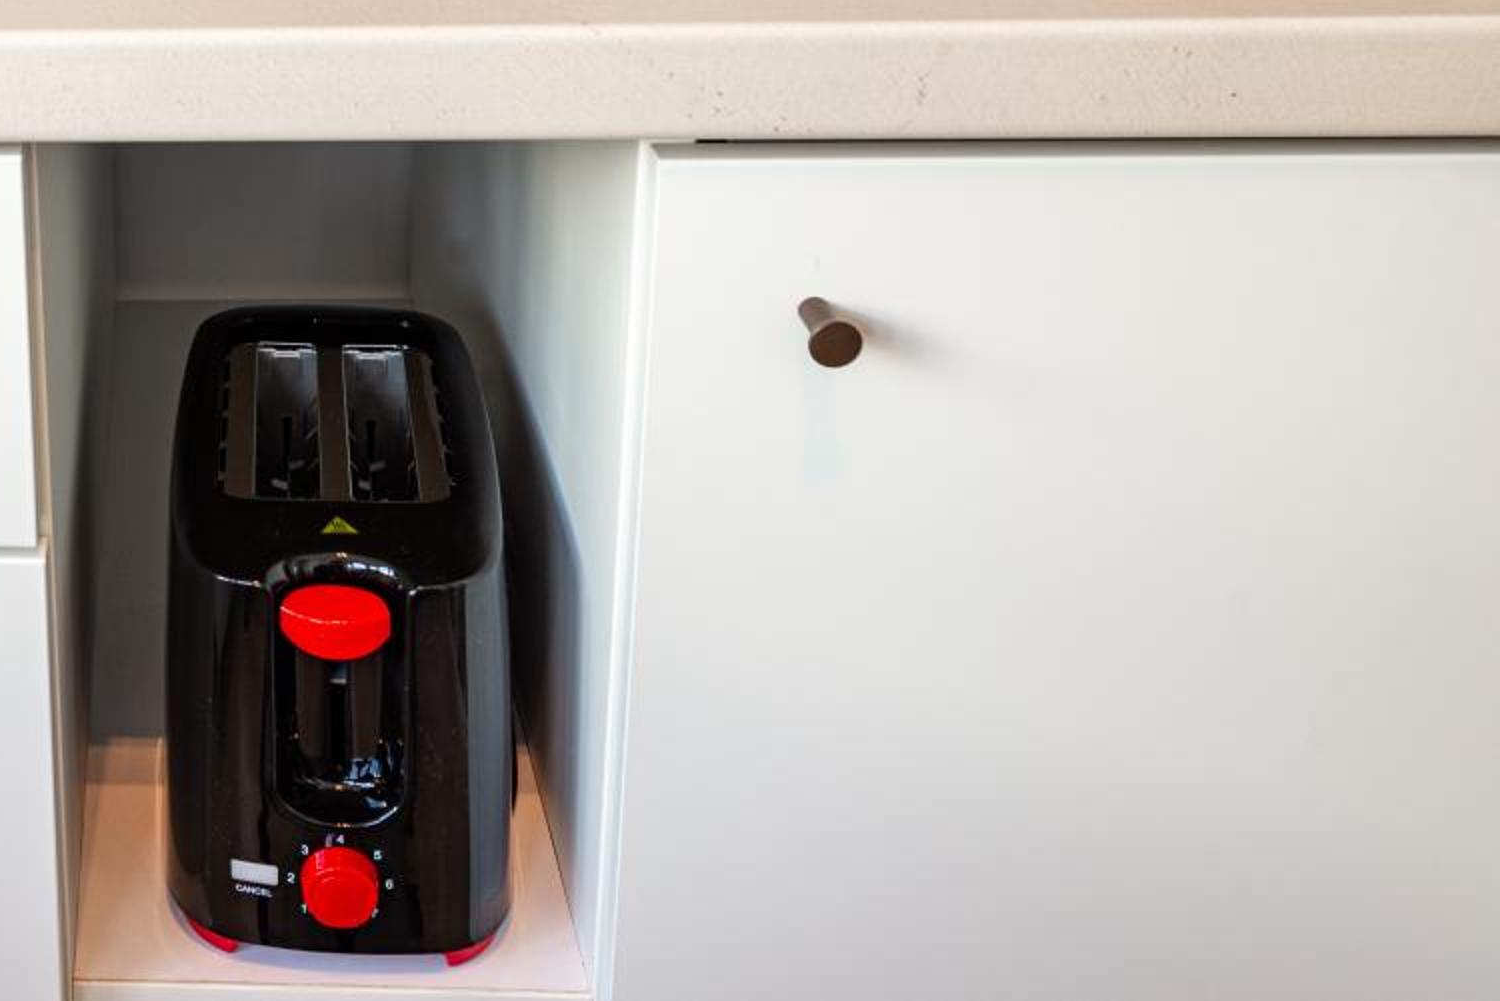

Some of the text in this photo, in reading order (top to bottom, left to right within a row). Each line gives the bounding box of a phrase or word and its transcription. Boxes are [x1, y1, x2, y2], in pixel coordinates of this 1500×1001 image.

[337, 834, 345, 844] 4
[301, 844, 309, 856] 3
[374, 850, 382, 860] 5
[287, 872, 295, 883] 2
[235, 883, 272, 897] CANCEL
[385, 879, 394, 890] 6
